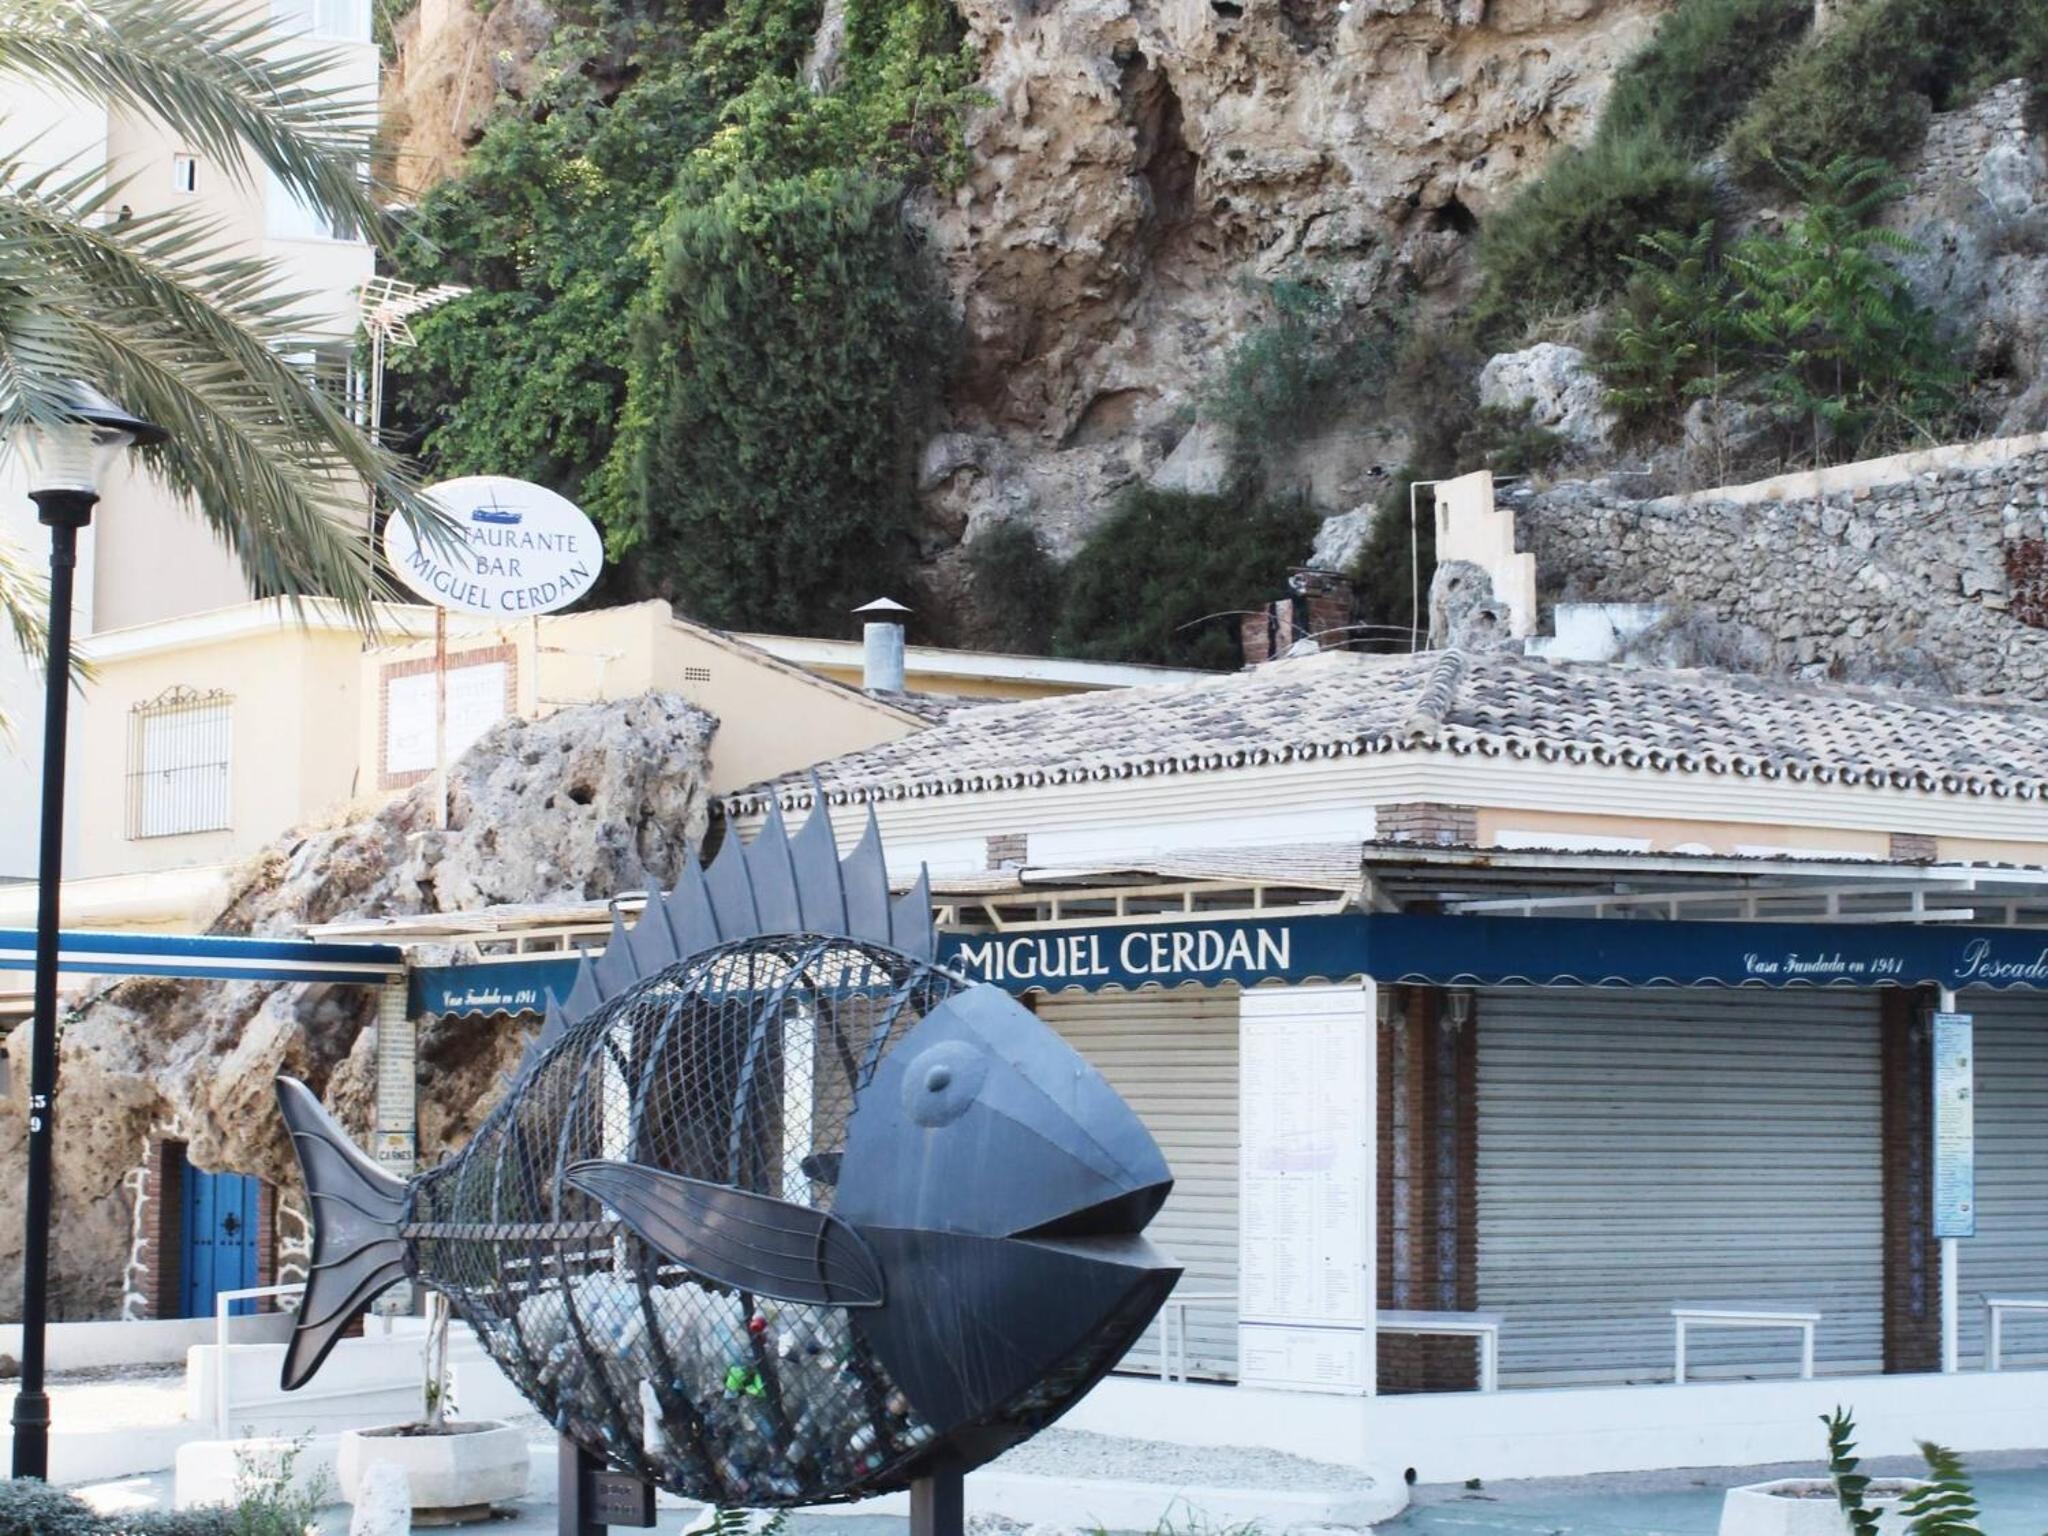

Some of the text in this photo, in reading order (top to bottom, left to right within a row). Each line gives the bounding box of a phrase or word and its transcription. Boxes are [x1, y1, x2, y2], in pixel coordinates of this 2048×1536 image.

[424, 523, 579, 553] TAURANTE
[405, 549, 591, 612] MIGUEL CERDAN
[475, 556, 523, 578] BAR
[960, 928, 1291, 981] MIGUEL CERDAN
[1743, 952, 1904, 974] Casa Fundada en 1941
